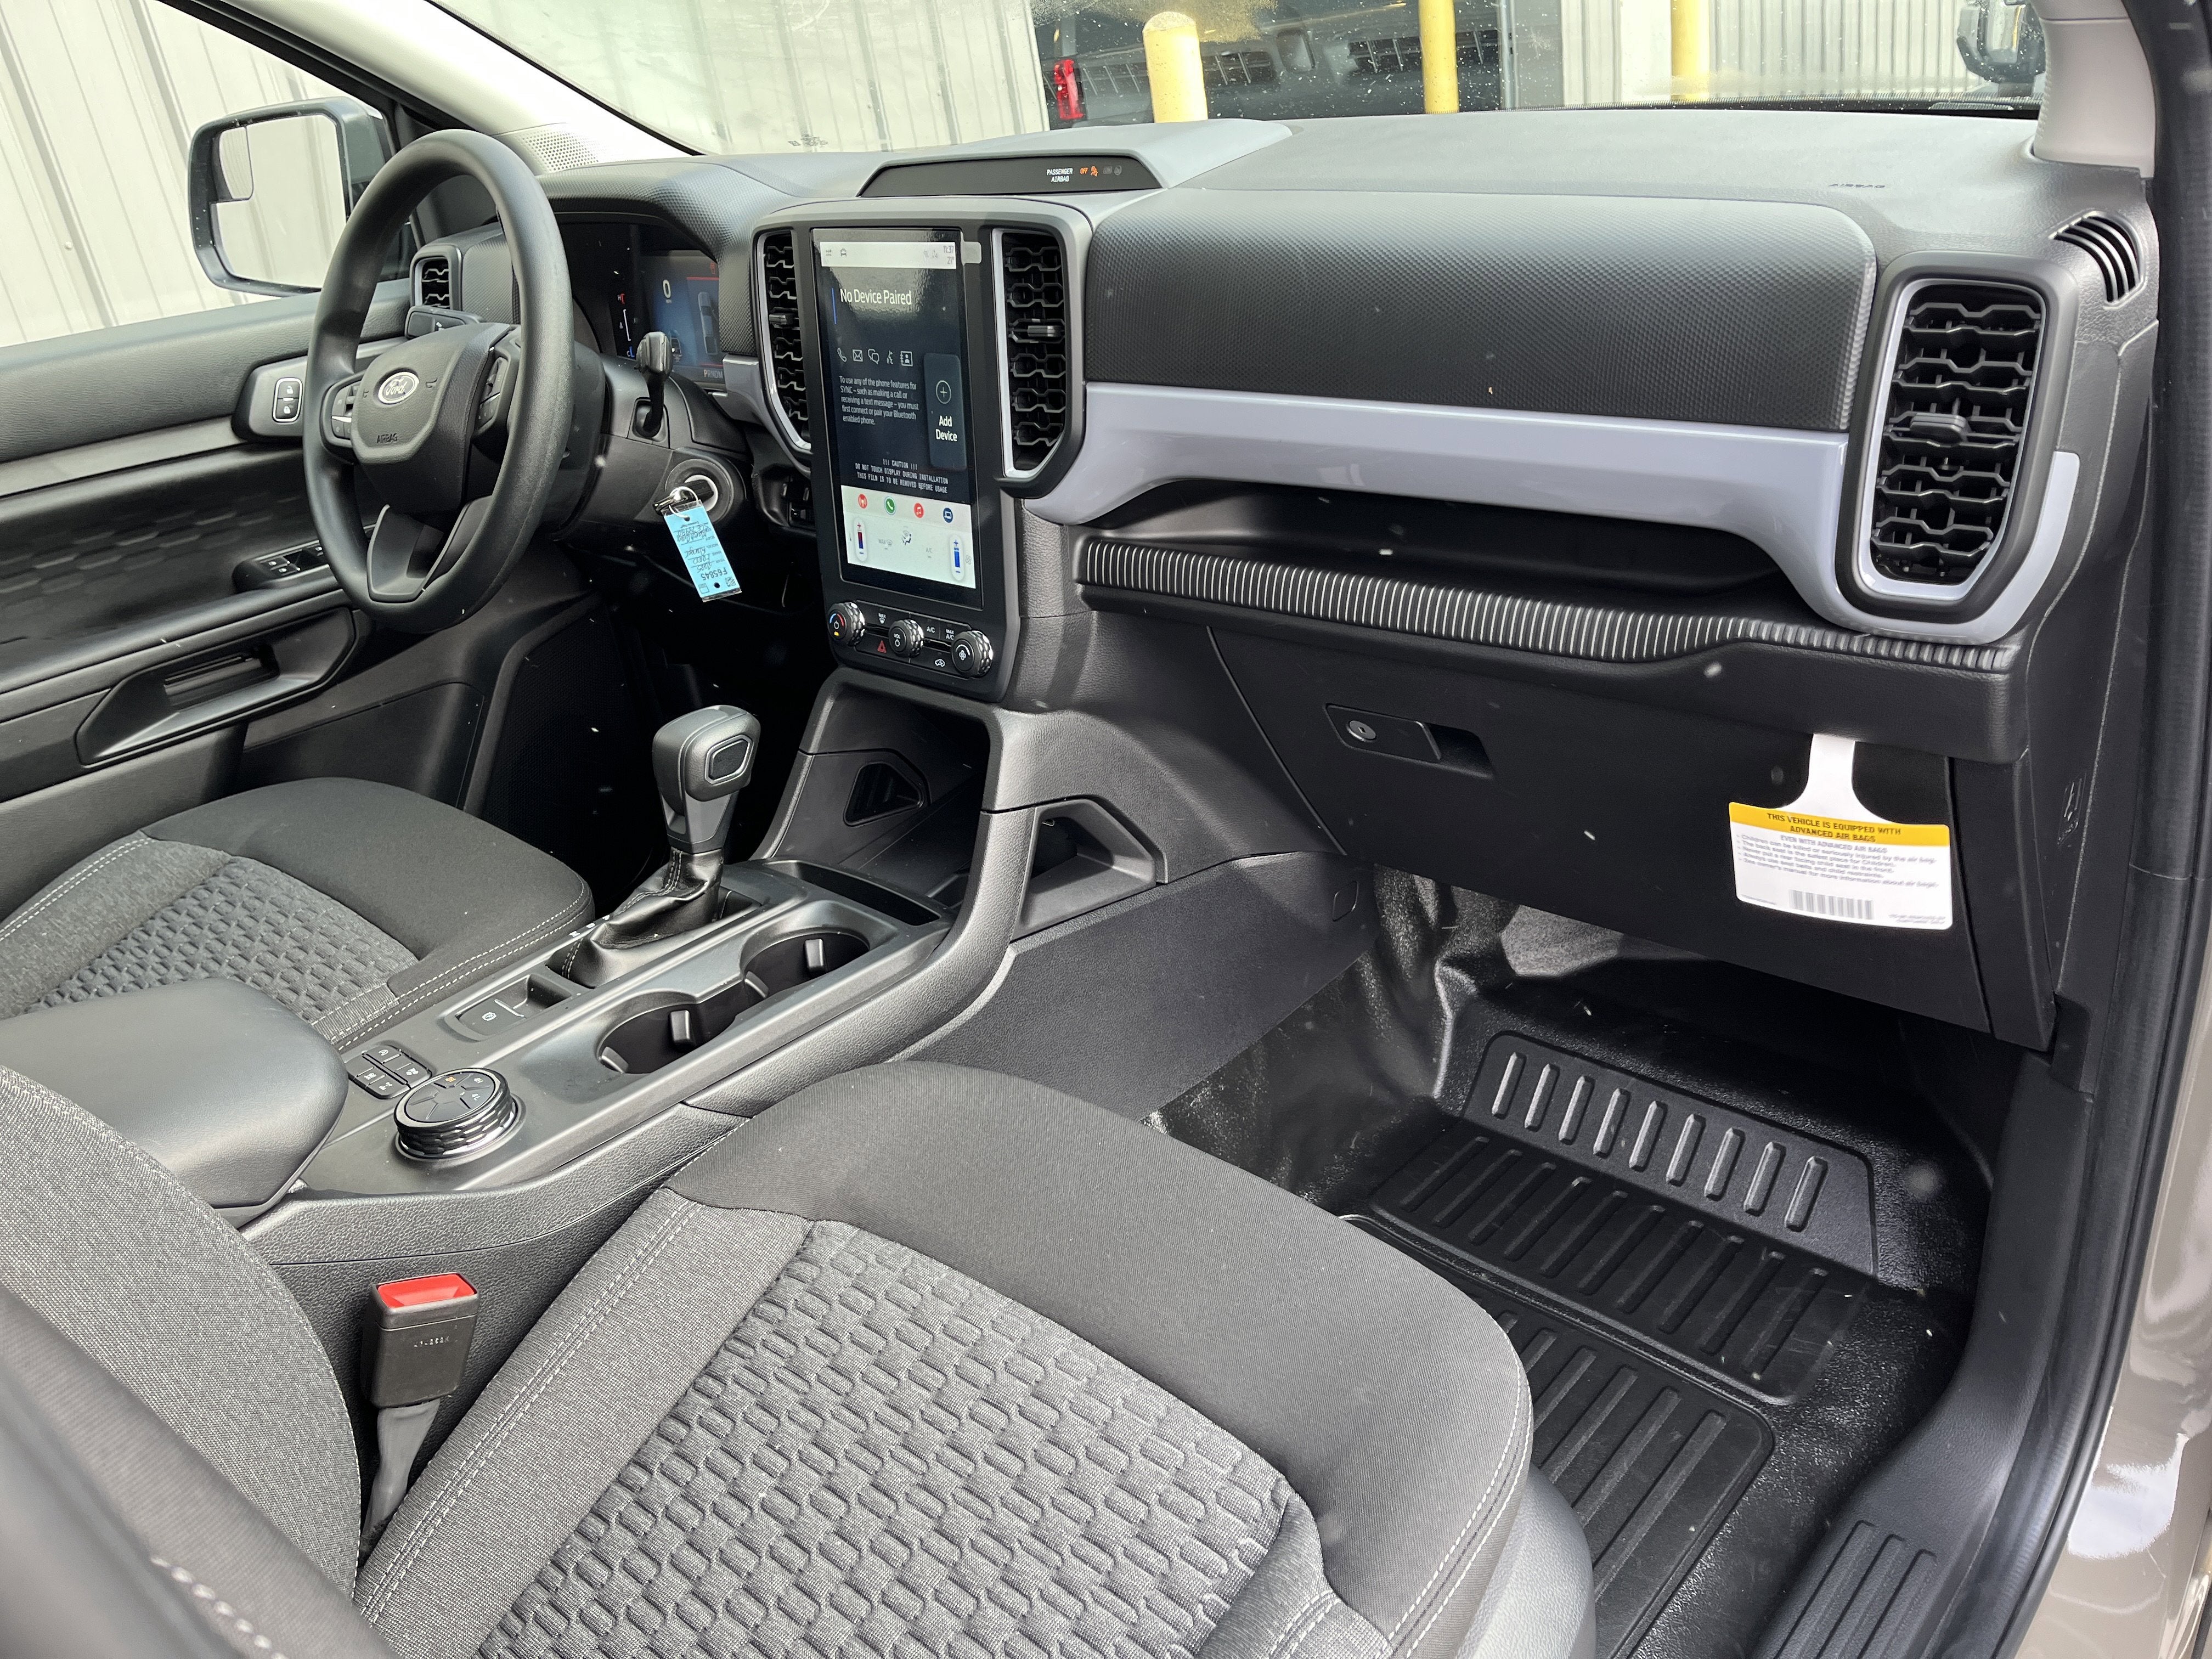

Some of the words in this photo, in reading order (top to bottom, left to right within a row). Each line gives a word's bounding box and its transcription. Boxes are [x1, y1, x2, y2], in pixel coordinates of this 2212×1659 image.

[663, 279, 671, 298] 0
[840, 289, 853, 303] No
[854, 289, 882, 304] Device
[883, 290, 912, 305] Paired
[876, 379, 890, 388] phone
[890, 380, 910, 390] features
[840, 385, 853, 394] SYNC
[873, 390, 890, 399] making
[894, 390, 902, 399] call
[841, 396, 860, 405] receiving
[873, 399, 893, 408] message
[898, 402, 906, 410] you
[842, 404, 850, 413] first
[851, 407, 868, 415] connect
[893, 410, 917, 420] Bluetooth
[842, 415, 860, 423] enabled
[860, 416, 876, 425] phone.
[939, 415, 952, 427] Add
[935, 428, 957, 442] Device
[891, 460, 909, 469] CAUTION
[871, 465, 883, 473] TOUCH
[884, 467, 901, 476] DISPLAY
[902, 471, 918, 479] DURING
[919, 473, 949, 484] INSTALLATION
[857, 471, 866, 479] THIS
[900, 479, 917, 488] REMOVED
[918, 482, 933, 491] BEFORE
[934, 485, 948, 494] USAGE
[701, 567, 727, 580] F65845
[1767, 813, 1785, 822] THIS
[1787, 816, 1821, 827] VEHICLE
[1833, 822, 1875, 833] EQUIPPED
[1790, 826, 1833, 837] ADVANCED
[1853, 834, 1875, 843] BAGS
[1817, 840, 1853, 850] ADVANCED
